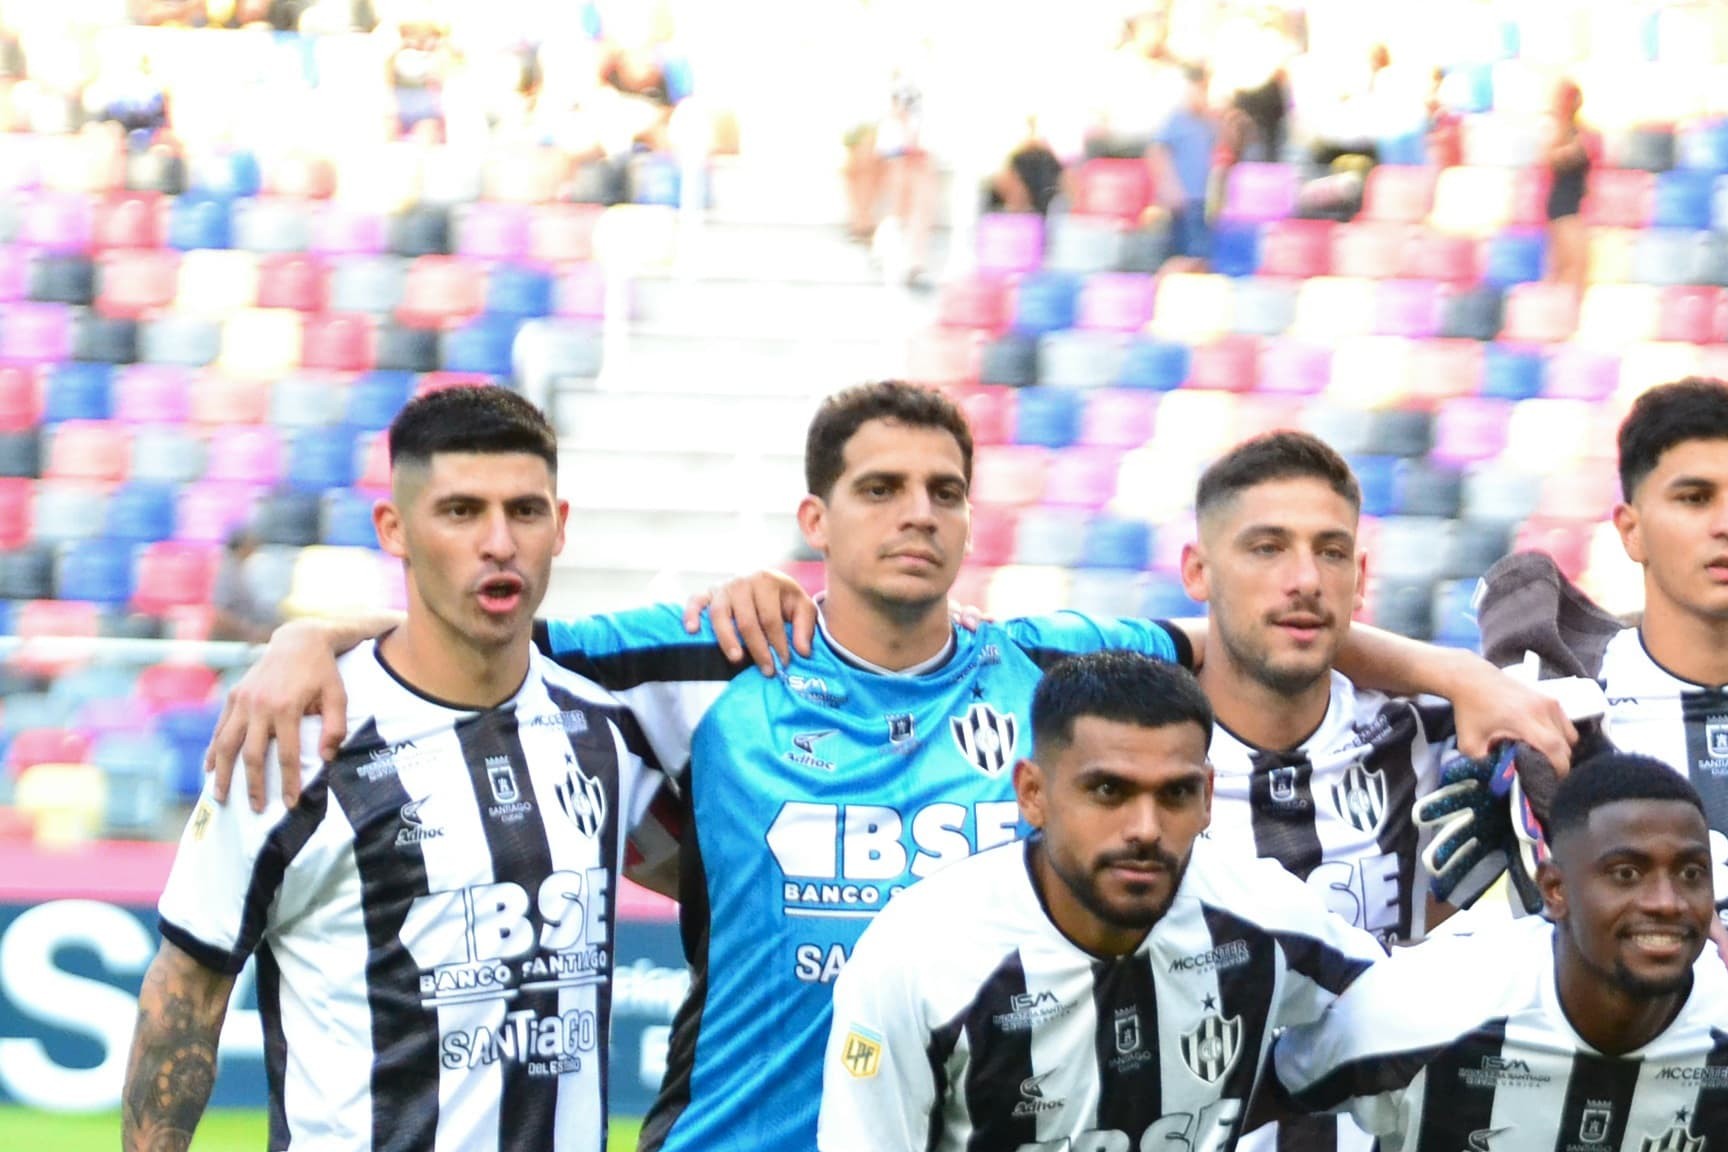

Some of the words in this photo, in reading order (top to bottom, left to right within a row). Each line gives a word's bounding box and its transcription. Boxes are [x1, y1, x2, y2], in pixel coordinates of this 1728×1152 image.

[395, 826, 445, 846] Adhoc
[784, 883, 878, 904] BANCO
[474, 867, 610, 964] BSE
[419, 965, 512, 993] BANCO
[521, 949, 607, 978] SANTIAGO
[1010, 990, 1059, 1012] ISM
